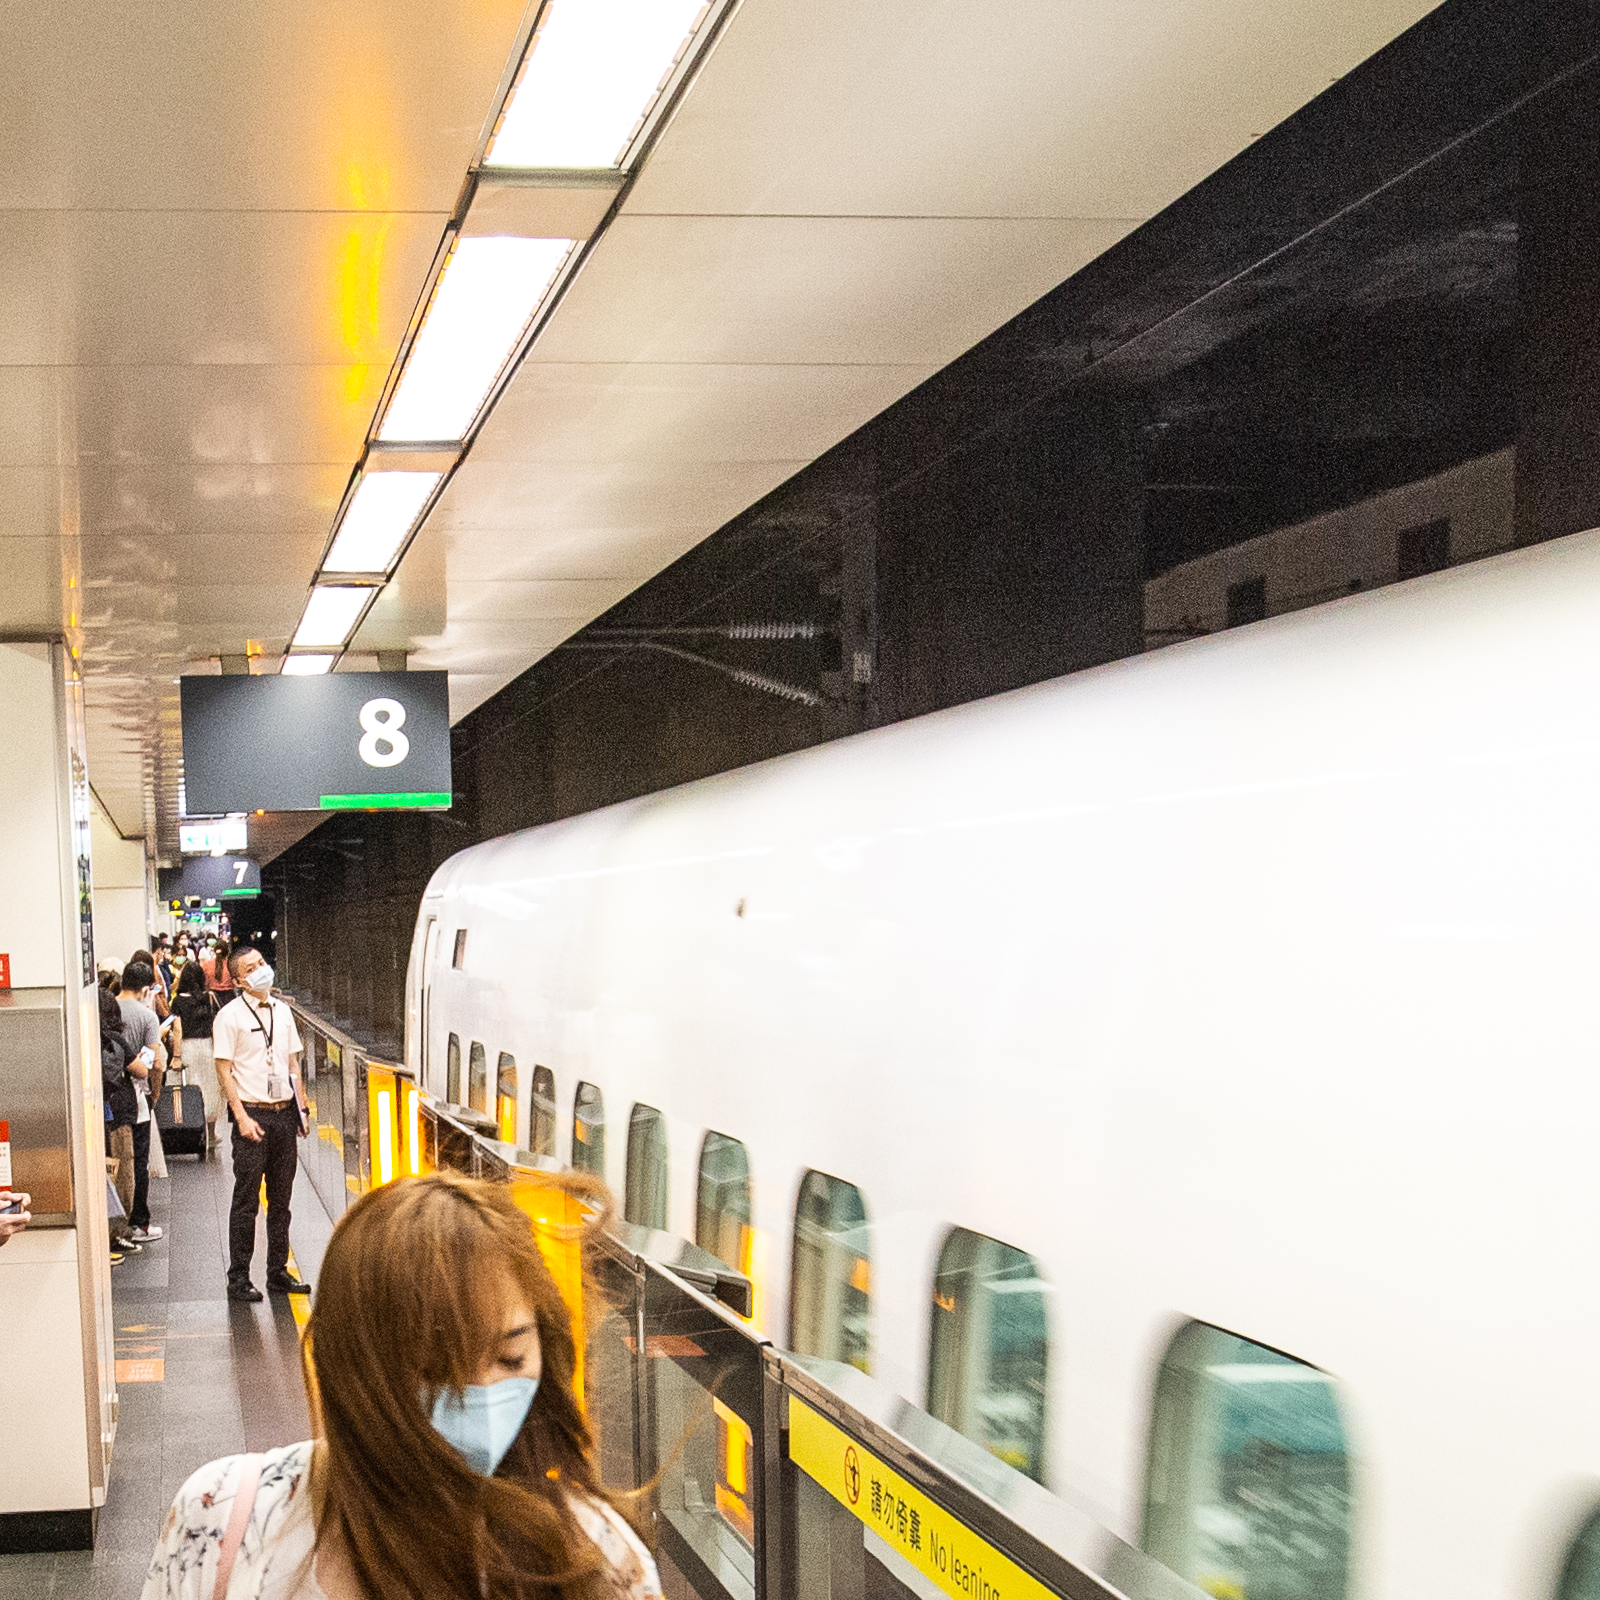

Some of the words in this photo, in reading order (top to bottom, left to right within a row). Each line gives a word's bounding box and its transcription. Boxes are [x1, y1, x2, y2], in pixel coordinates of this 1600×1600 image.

[357, 697, 410, 768] 8
[233, 861, 249, 885] 7
[870, 1475, 922, 1553] 請勿倚靠
[930, 1528, 947, 1573] No
